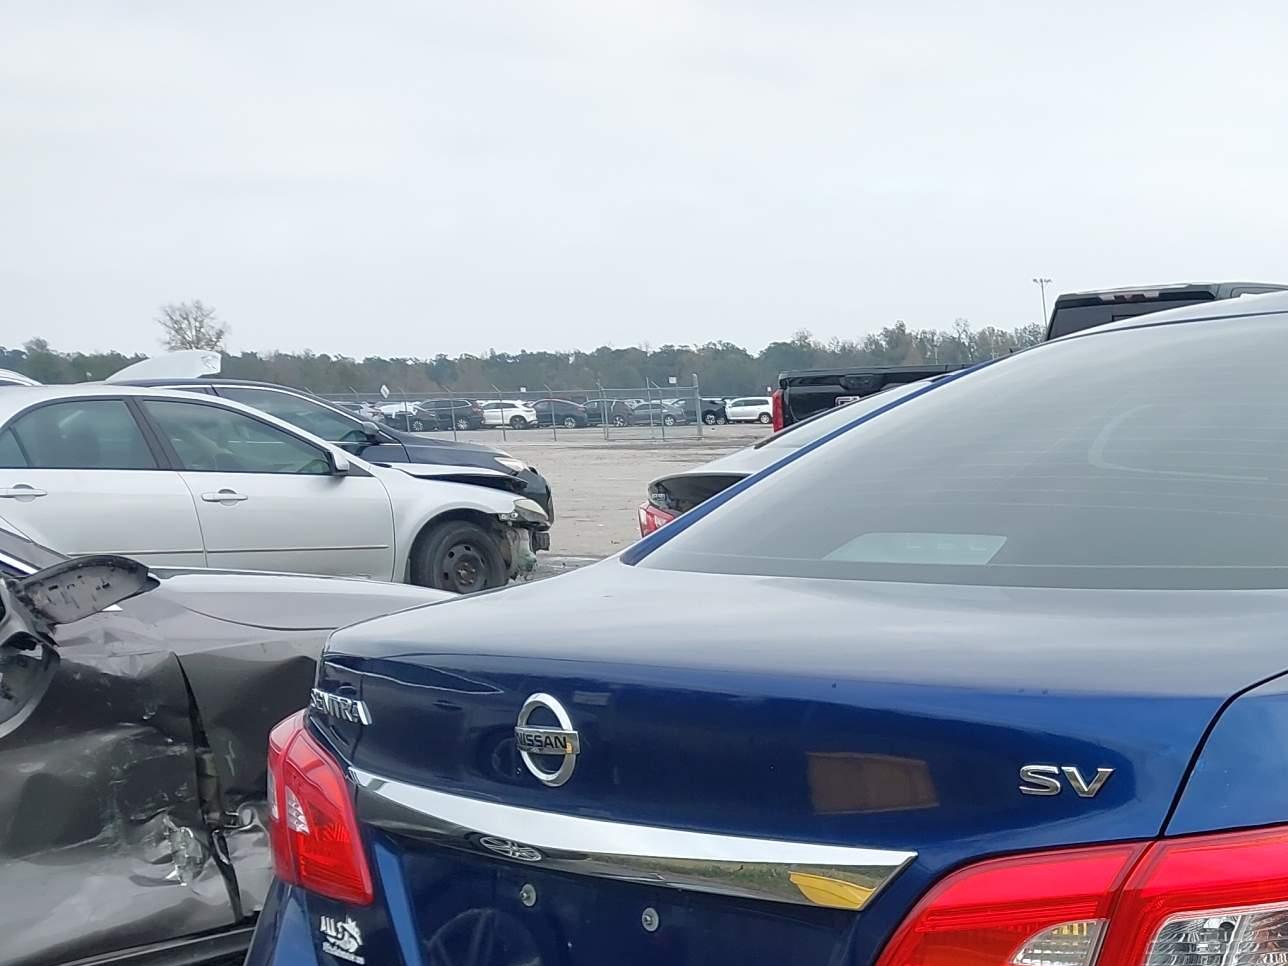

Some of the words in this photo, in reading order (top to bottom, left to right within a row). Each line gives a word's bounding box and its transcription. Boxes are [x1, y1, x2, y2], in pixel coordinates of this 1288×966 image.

[310, 688, 373, 725] SENTRA
[518, 731, 567, 749] NISSAN
[1019, 764, 1115, 798] SV
